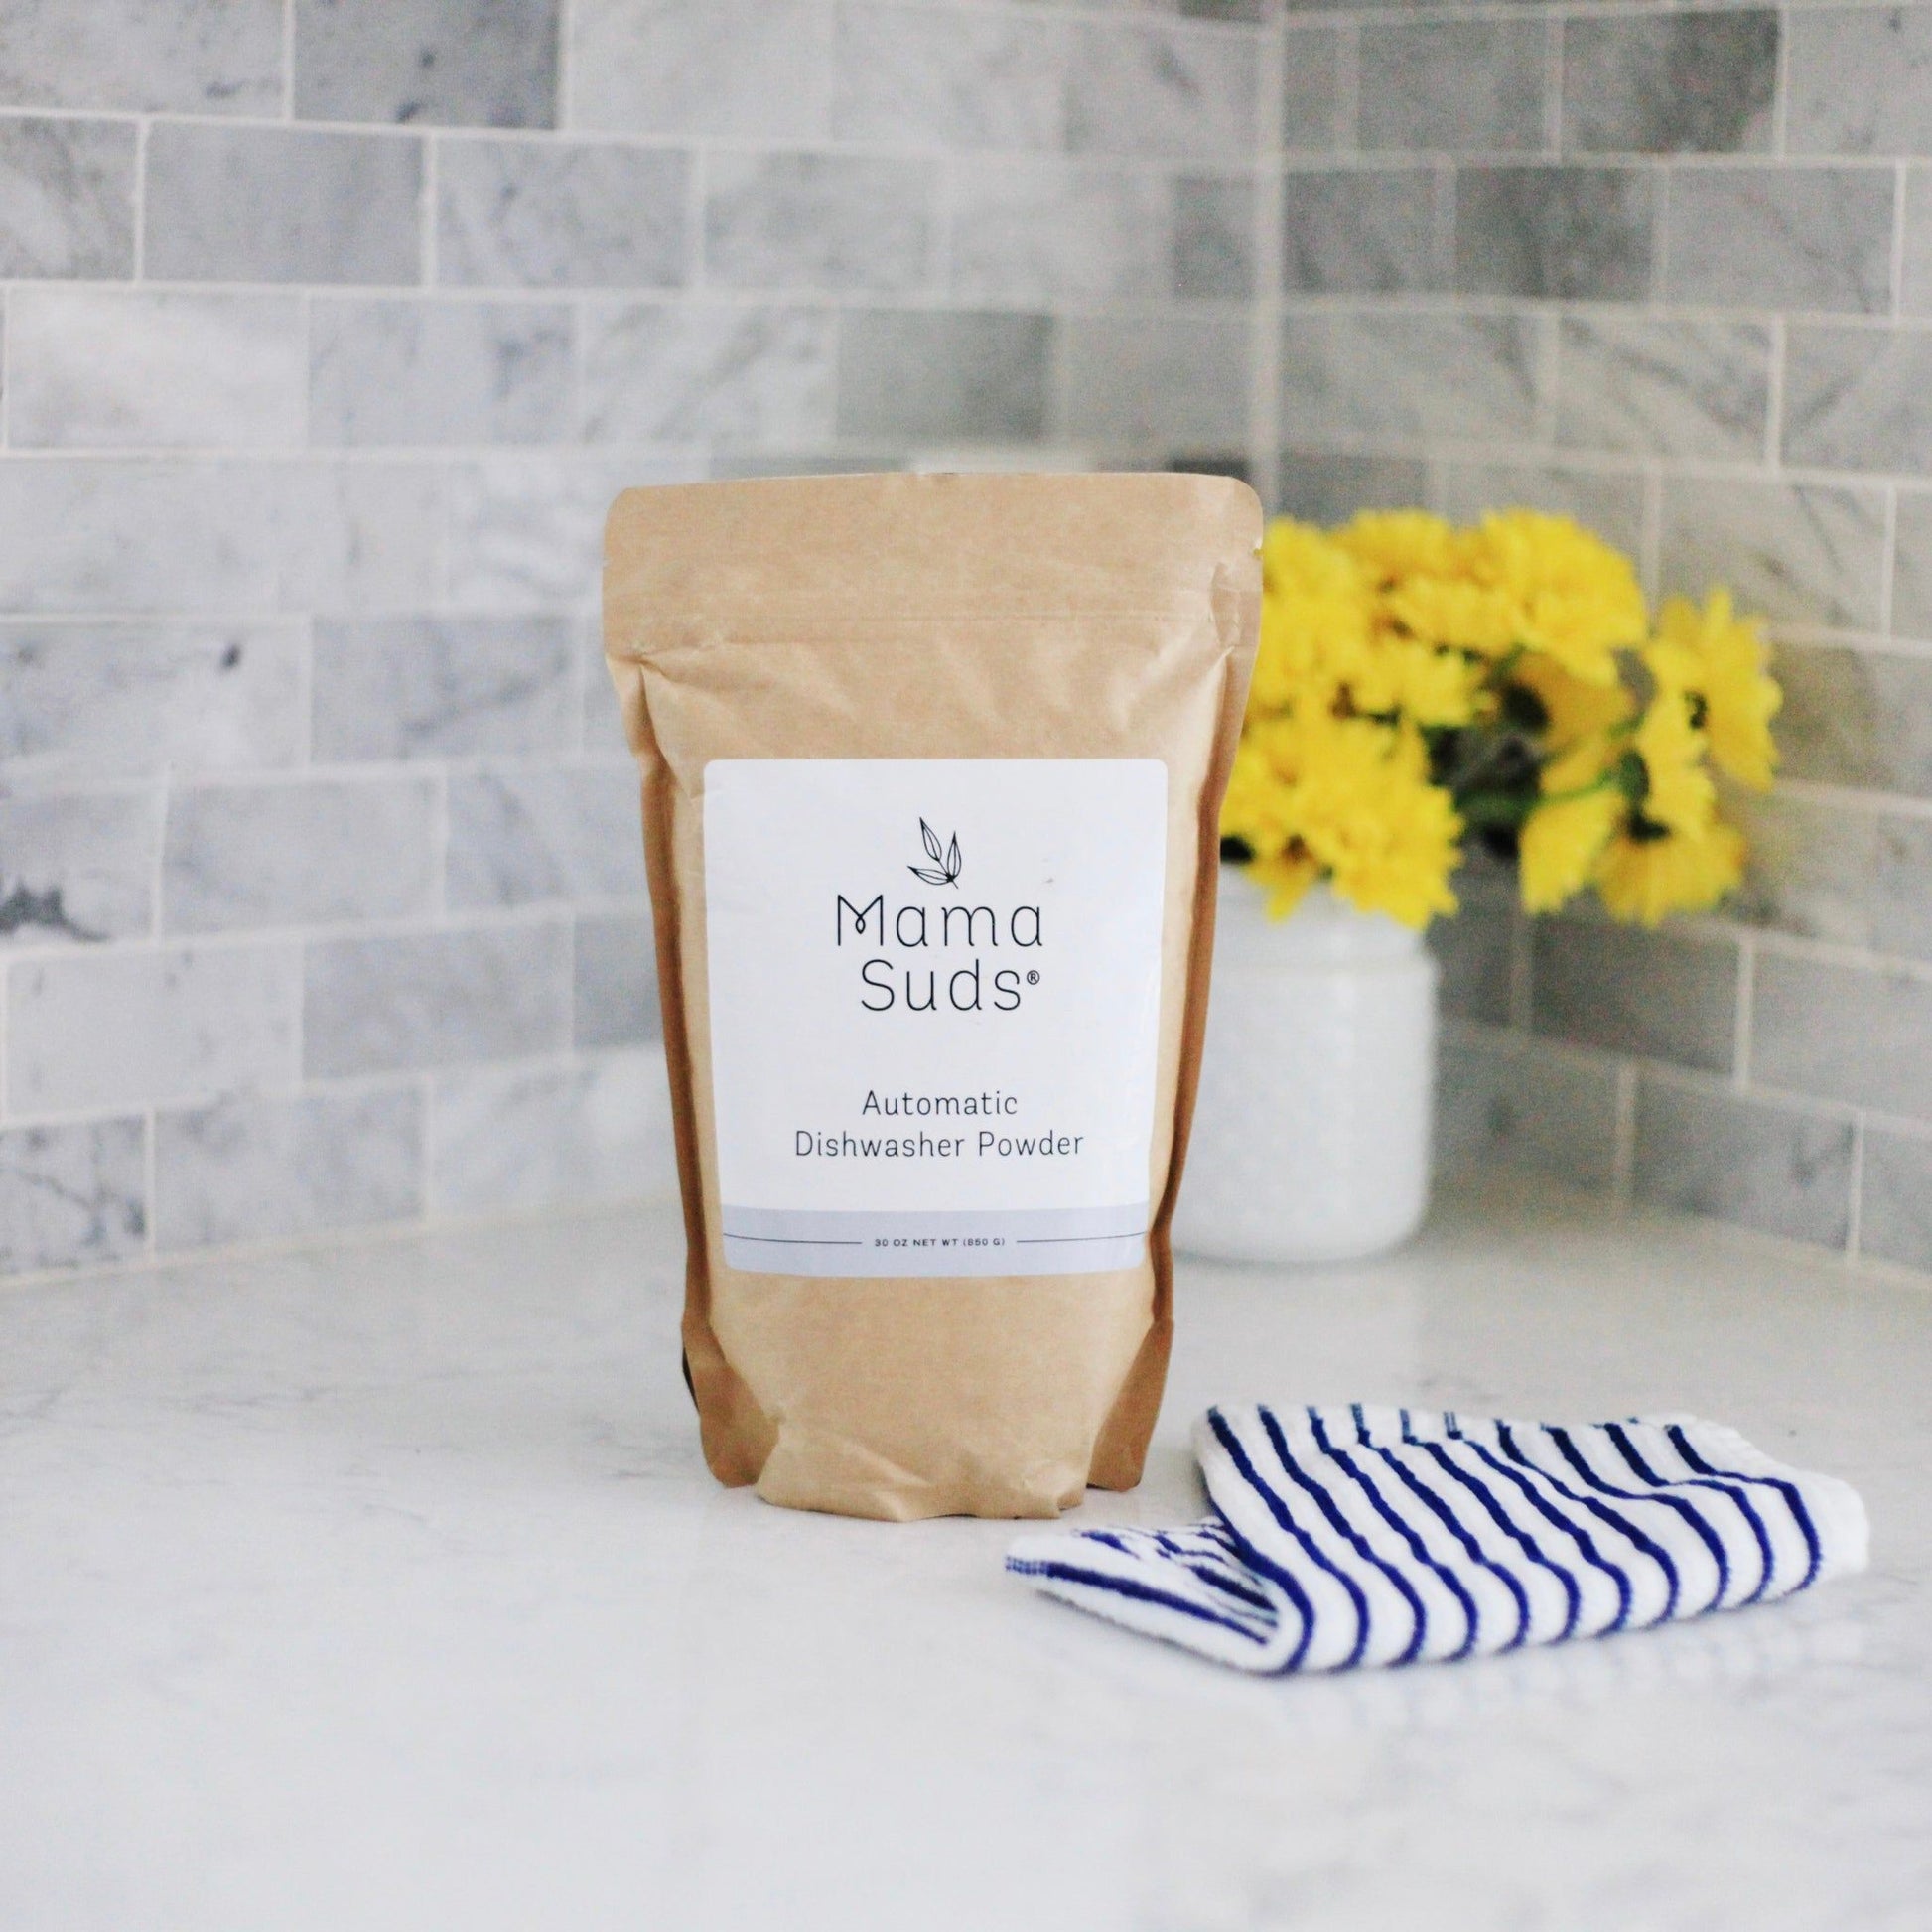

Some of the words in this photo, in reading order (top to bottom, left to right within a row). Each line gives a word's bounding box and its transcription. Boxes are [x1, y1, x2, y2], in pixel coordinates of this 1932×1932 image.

[836, 894, 1043, 948] Mama
[862, 1089, 1019, 1116] Automatic
[795, 1130, 966, 1158] Dishwasher
[979, 1129, 1084, 1157] Powder
[874, 1238, 889, 1247] 30
[893, 1238, 908, 1247] OZ
[912, 1238, 936, 1247] NET
[941, 1238, 959, 1247] WT
[992, 1237, 1006, 1247] G)
